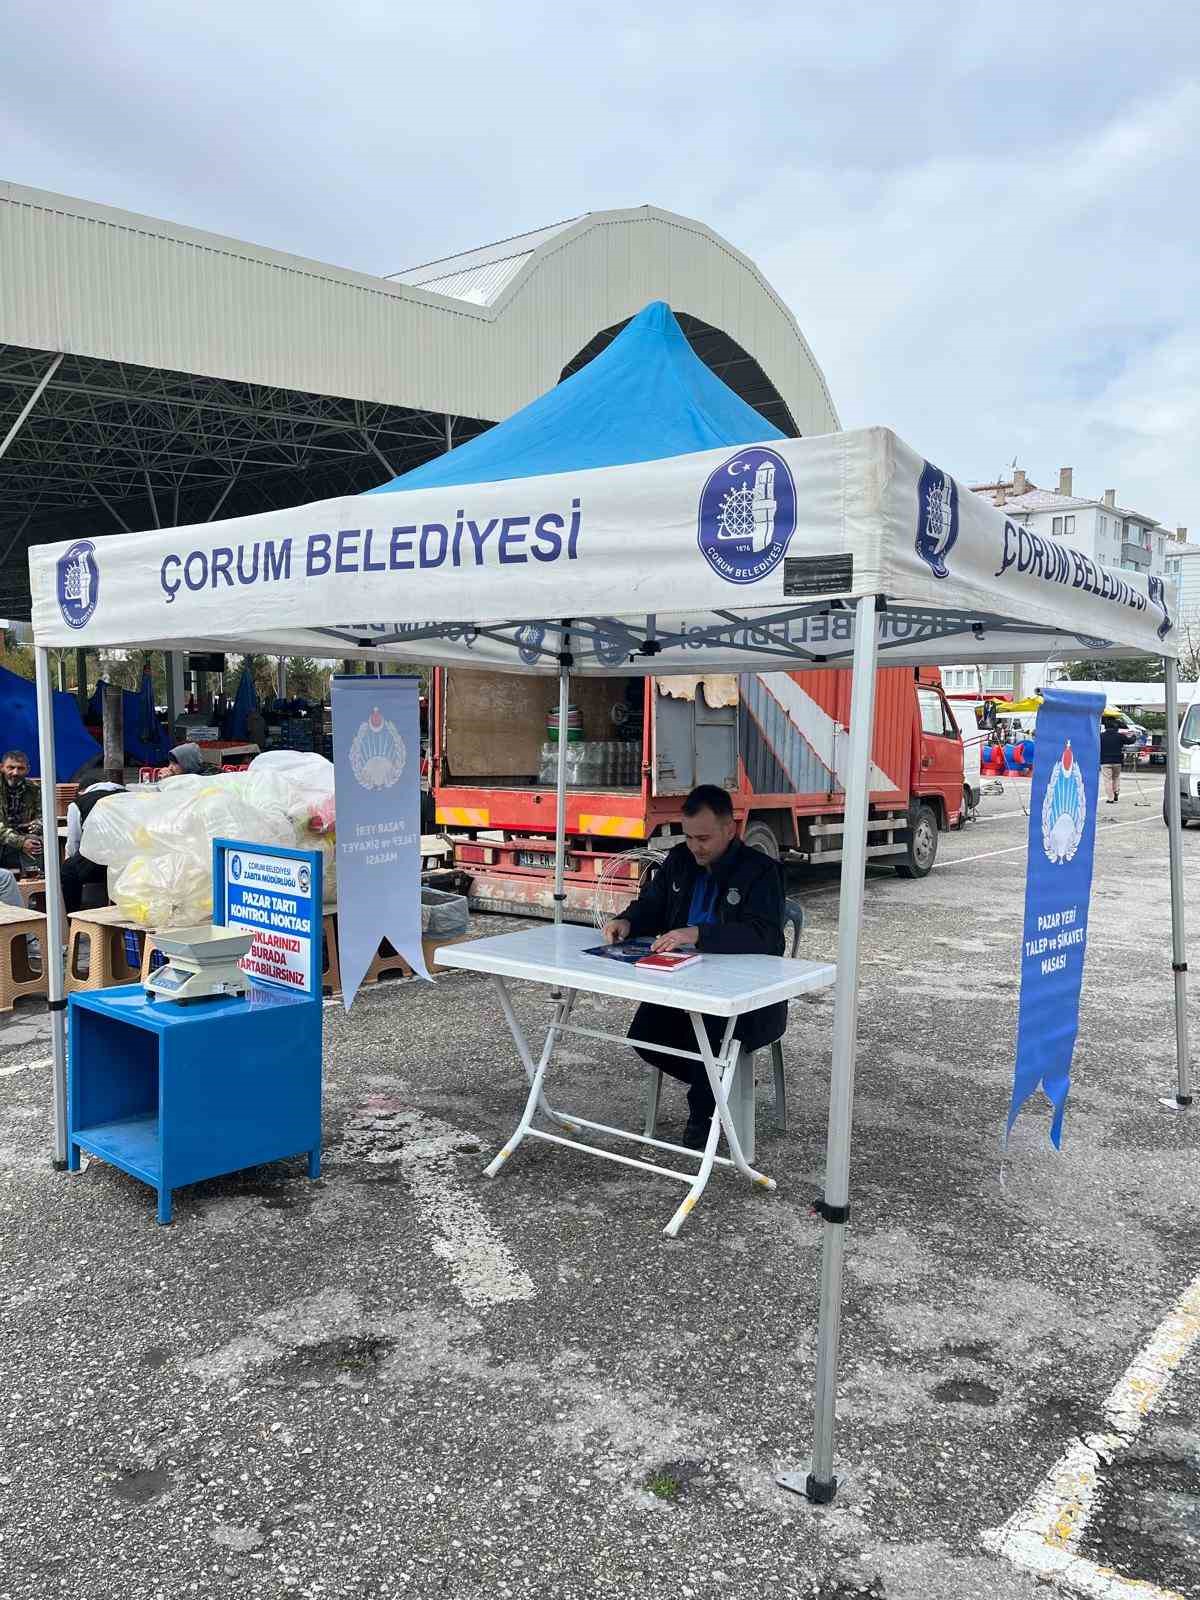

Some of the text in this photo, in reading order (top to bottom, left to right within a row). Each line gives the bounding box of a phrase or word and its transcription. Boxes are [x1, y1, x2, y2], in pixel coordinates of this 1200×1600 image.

[160, 497, 581, 603] ÇORUM BELEDİYESİ
[995, 520, 1070, 584] ÇORUM
[242, 891, 297, 914] PAZAR TARTI
[230, 903, 311, 933] KONTROL NOKTASI
[1037, 905, 1078, 931] PAZAR YERİ
[251, 945, 287, 966] BURADA
[1025, 937, 1048, 957] TALEP
[1049, 938, 1057, 950] ve
[1041, 951, 1067, 975] MASASI
